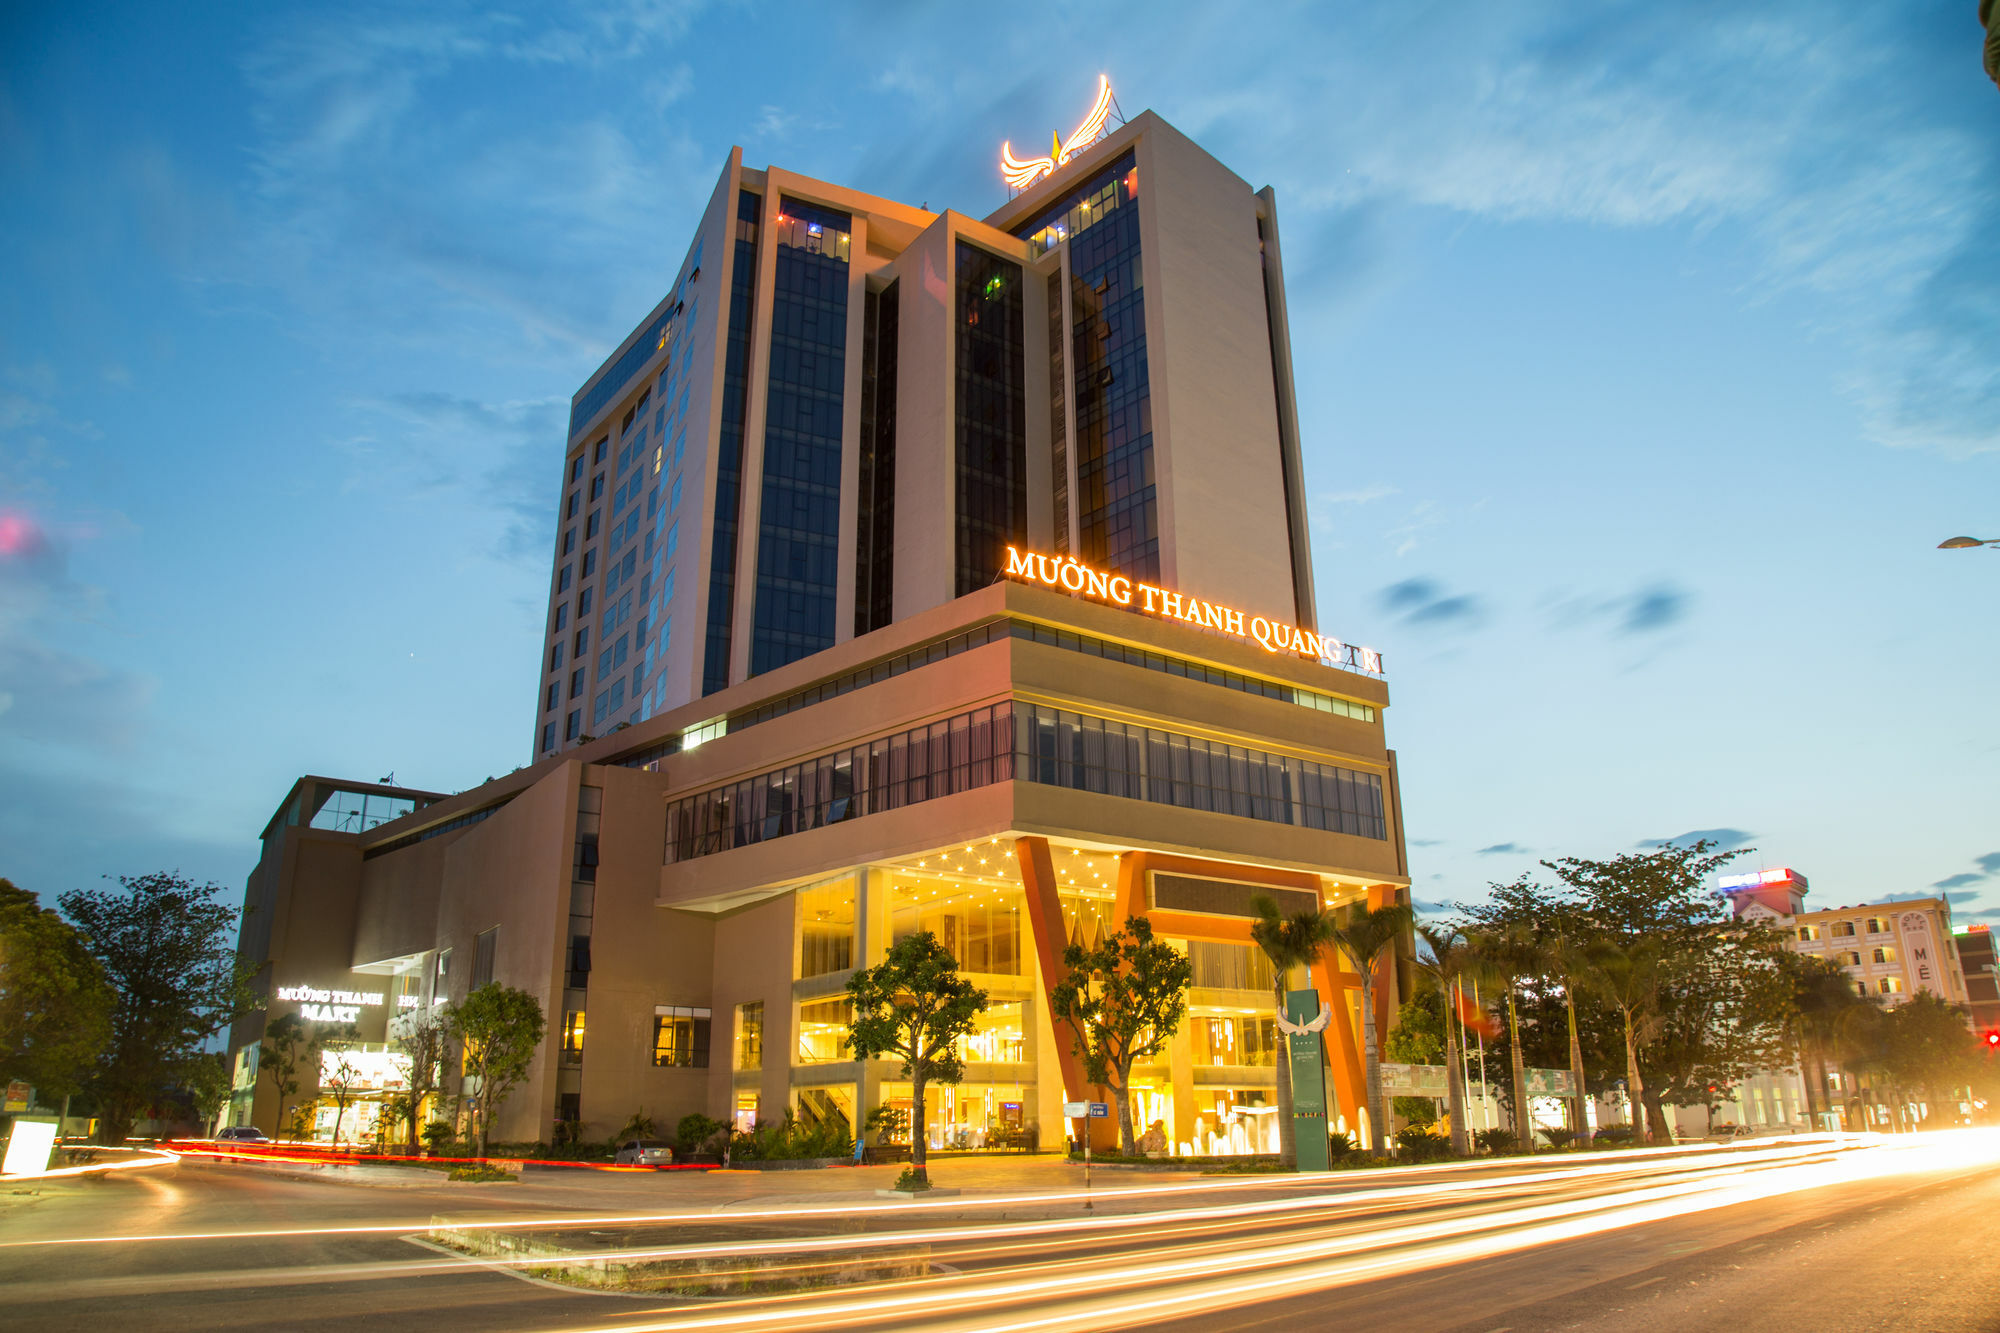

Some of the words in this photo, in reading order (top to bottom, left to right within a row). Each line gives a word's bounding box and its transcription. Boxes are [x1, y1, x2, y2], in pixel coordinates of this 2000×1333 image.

[1006, 546, 1132, 604] MƯỜNG
[1138, 583, 1246, 636] THANH
[331, 990, 384, 1006] THANH
[300, 1003, 361, 1022] MART
